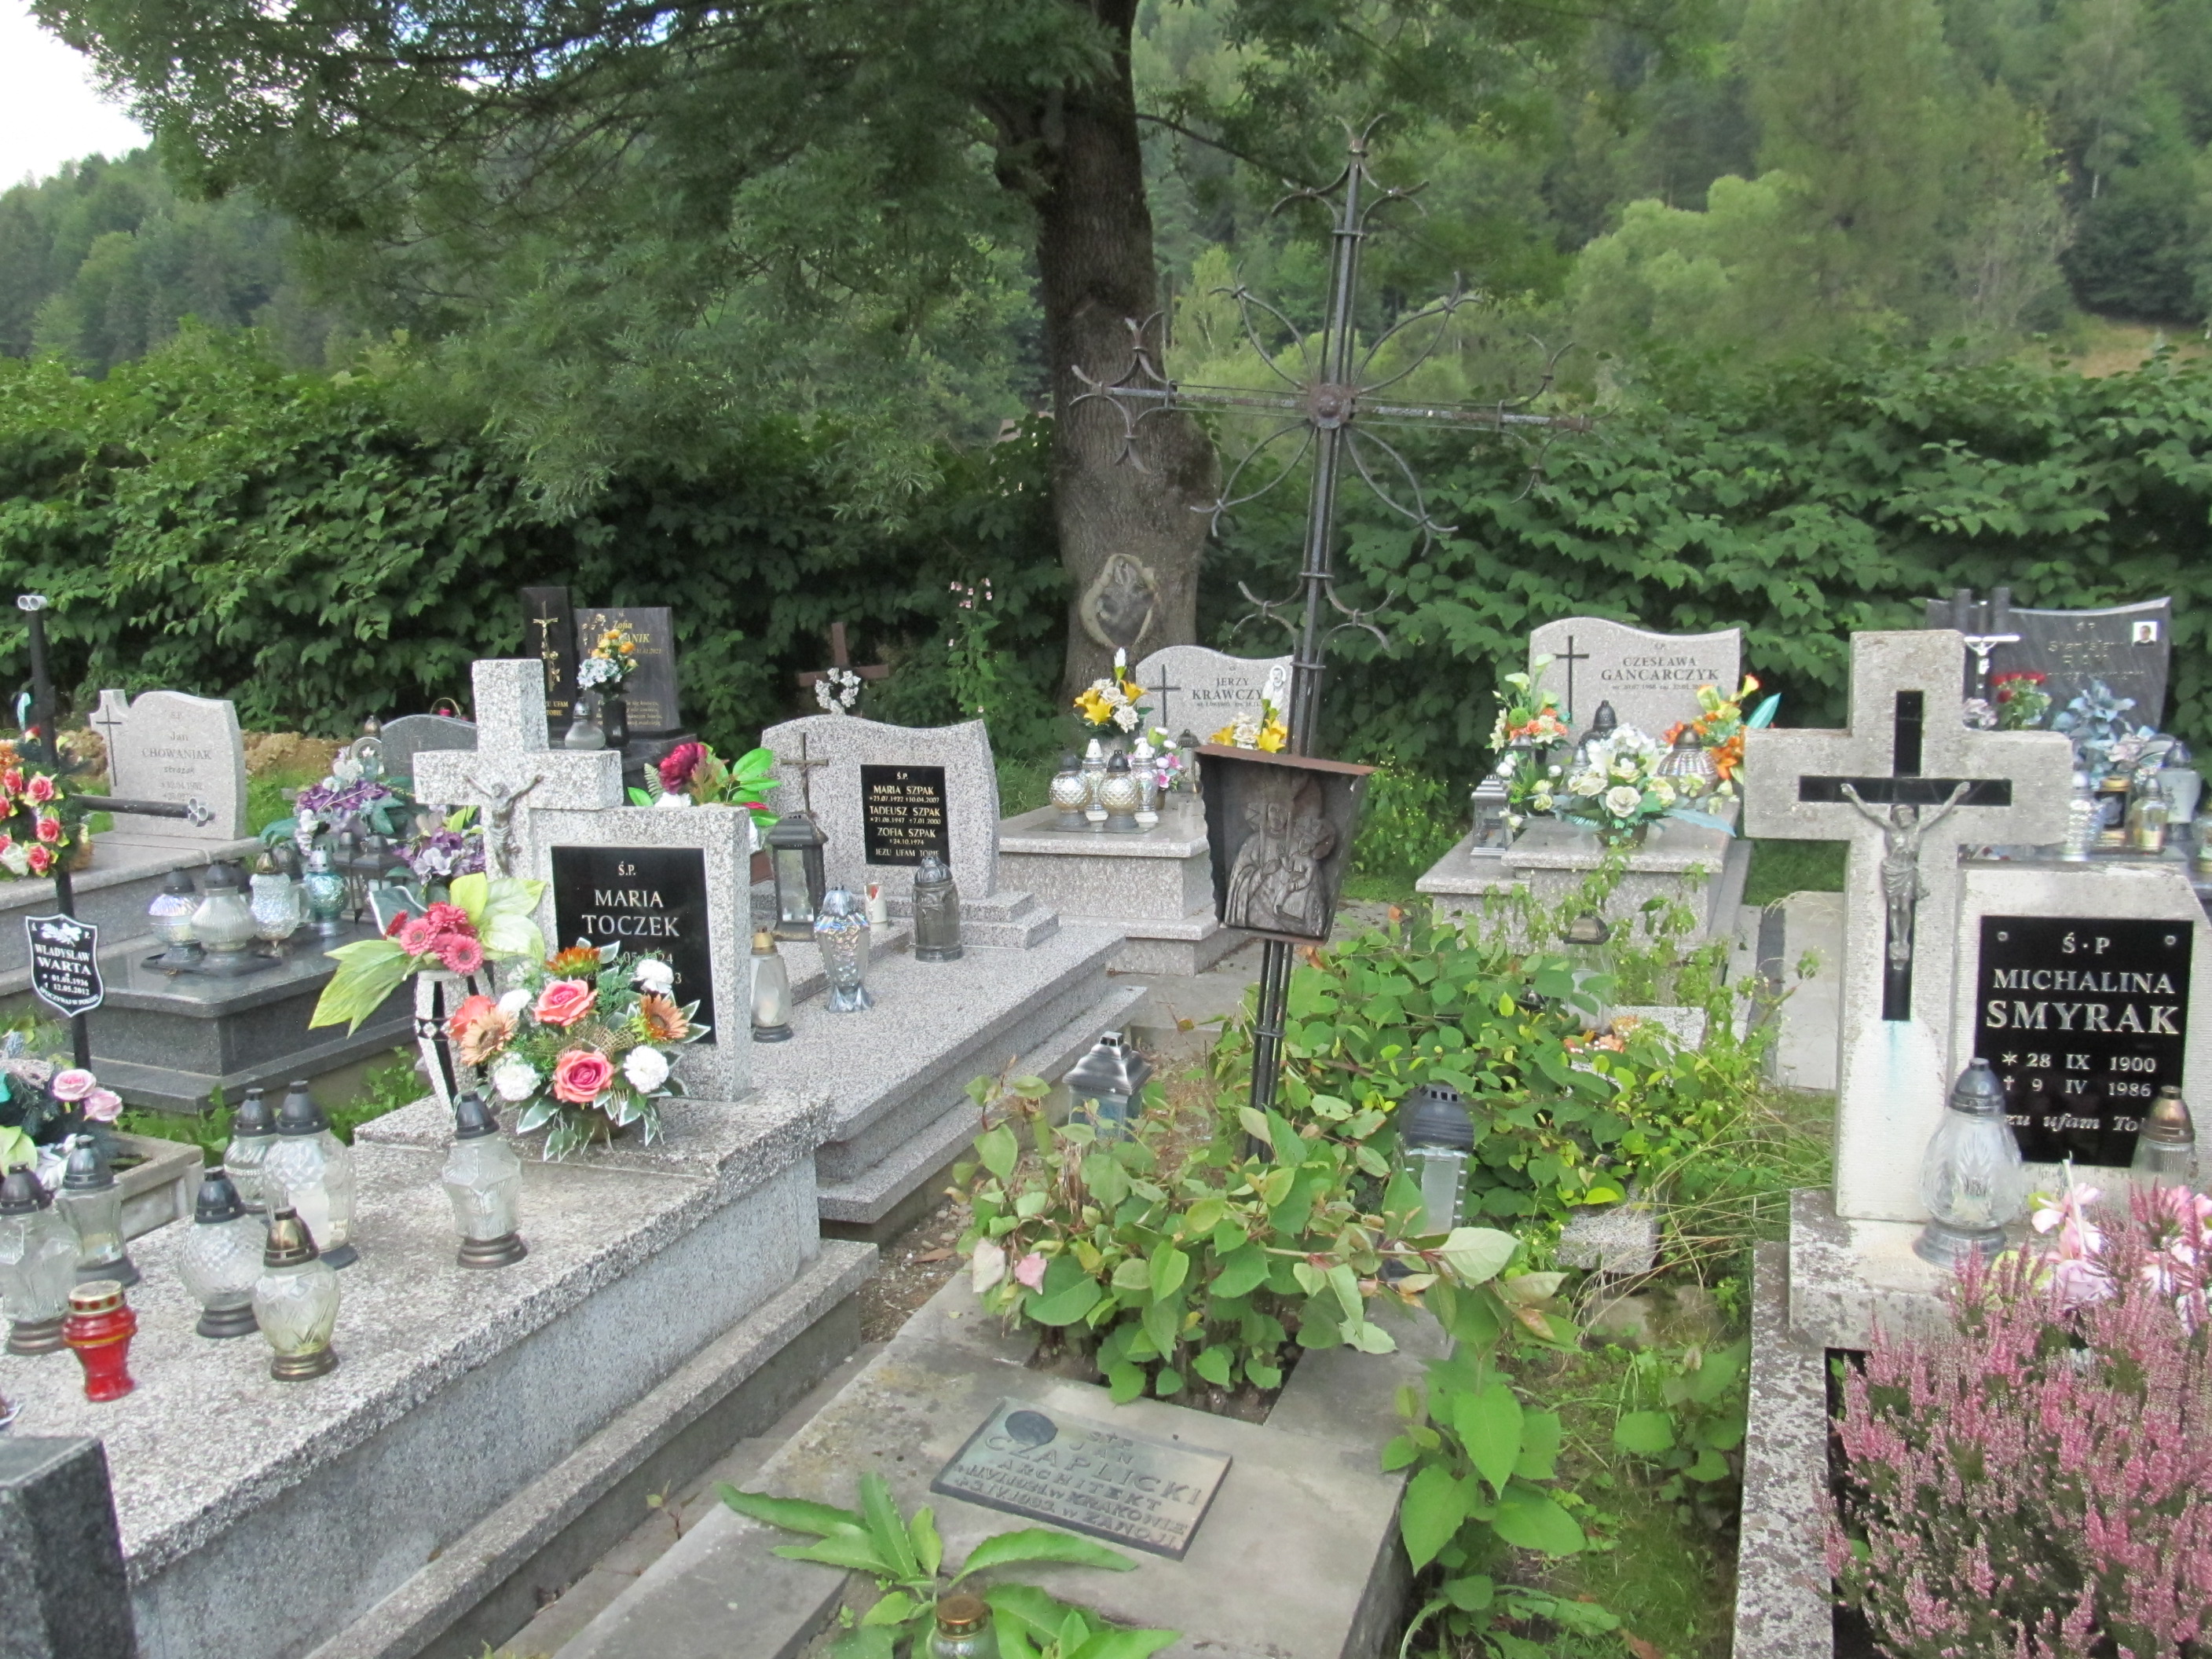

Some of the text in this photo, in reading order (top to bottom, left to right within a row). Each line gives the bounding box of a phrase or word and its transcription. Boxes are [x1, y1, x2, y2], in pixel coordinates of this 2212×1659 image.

[1623, 657, 1697, 667] CZESŁAWA
[1216, 677, 1250, 687] JERZY
[1601, 668, 1719, 681] GANCARCZYK
[1192, 689, 1263, 701] KRAWCZY
[170, 731, 189, 742] Jan
[141, 747, 213, 760] CHOWANIAK
[873, 786, 935, 796] MARIA SZPAK
[870, 806, 941, 817] TADEUSZ SZPAK
[877, 827, 936, 838] ZOFIA SZPAK
[595, 890, 664, 908] MARIA
[582, 915, 680, 937] TOCZEK
[37, 957, 92, 975] WARTA
[1993, 969, 2175, 994] MICHALINA
[1986, 1000, 2180, 1035] SMYRAK
[2026, 1053, 2157, 1073] 28 IX 1900
[2031, 1079, 2152, 1097] 9 IV 1986
[2043, 1112, 2100, 1132] ufam
[1069, 1440, 1133, 1464] JAN
[985, 1436, 1202, 1506] CZAPLICKI
[998, 1459, 1163, 1510] ARCHITEKT
